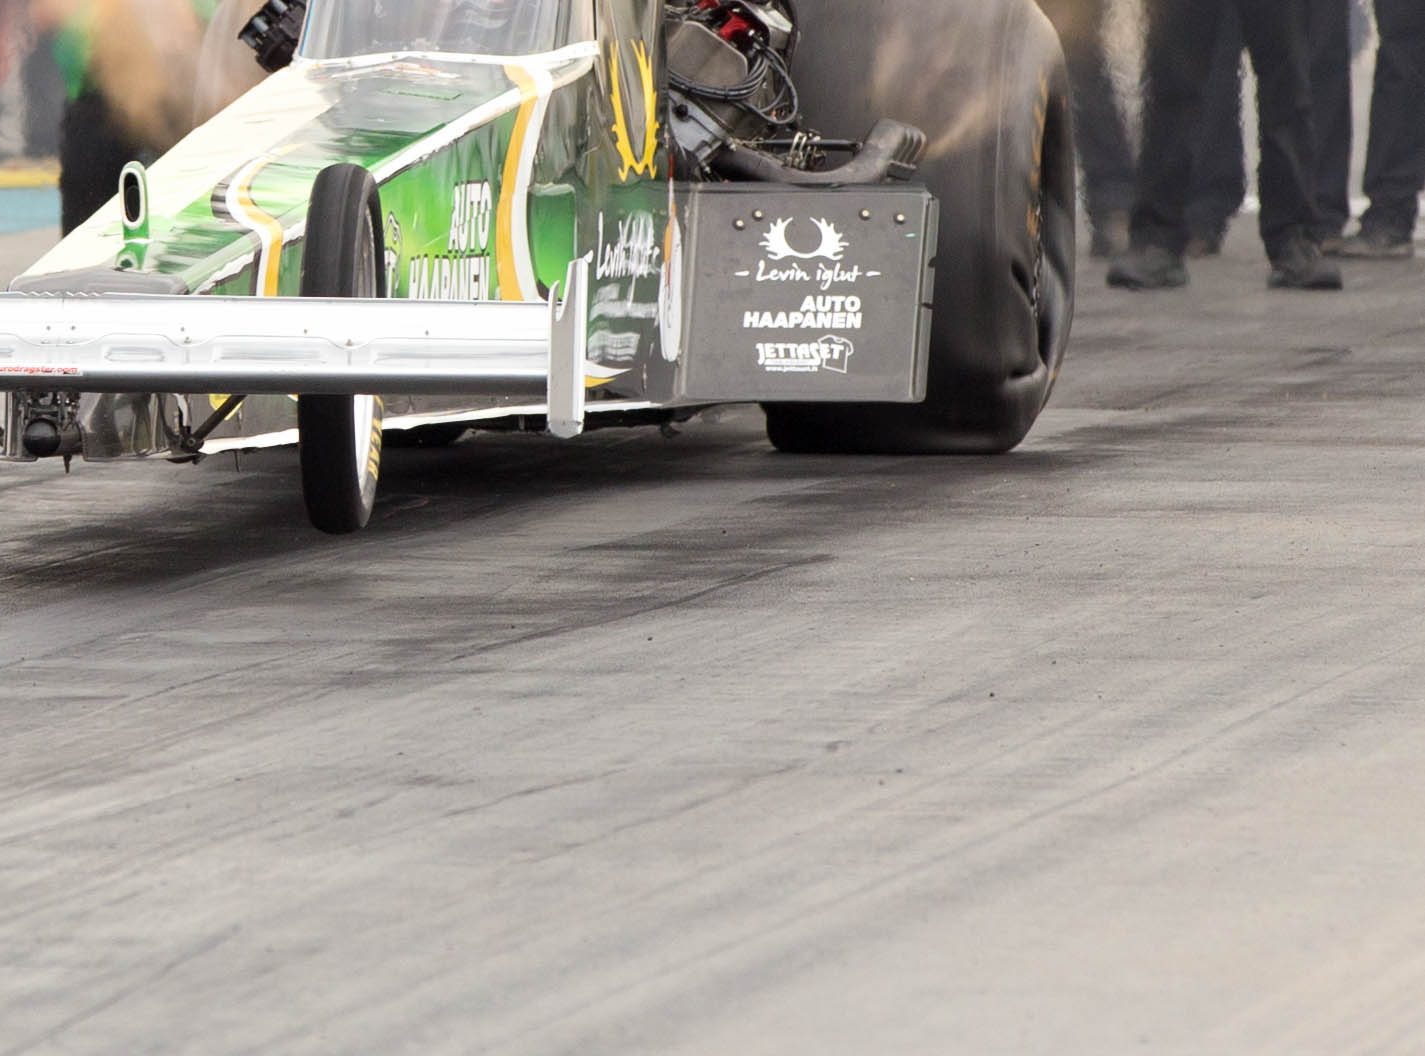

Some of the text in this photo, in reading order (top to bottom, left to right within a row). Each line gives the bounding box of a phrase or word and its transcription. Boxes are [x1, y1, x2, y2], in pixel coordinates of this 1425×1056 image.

[448, 180, 493, 253] AUTO
[755, 259, 863, 291] Levin iglut
[799, 295, 862, 313] AUTO
[742, 311, 863, 329] HAAPANEN
[755, 342, 845, 365] JETTASET
